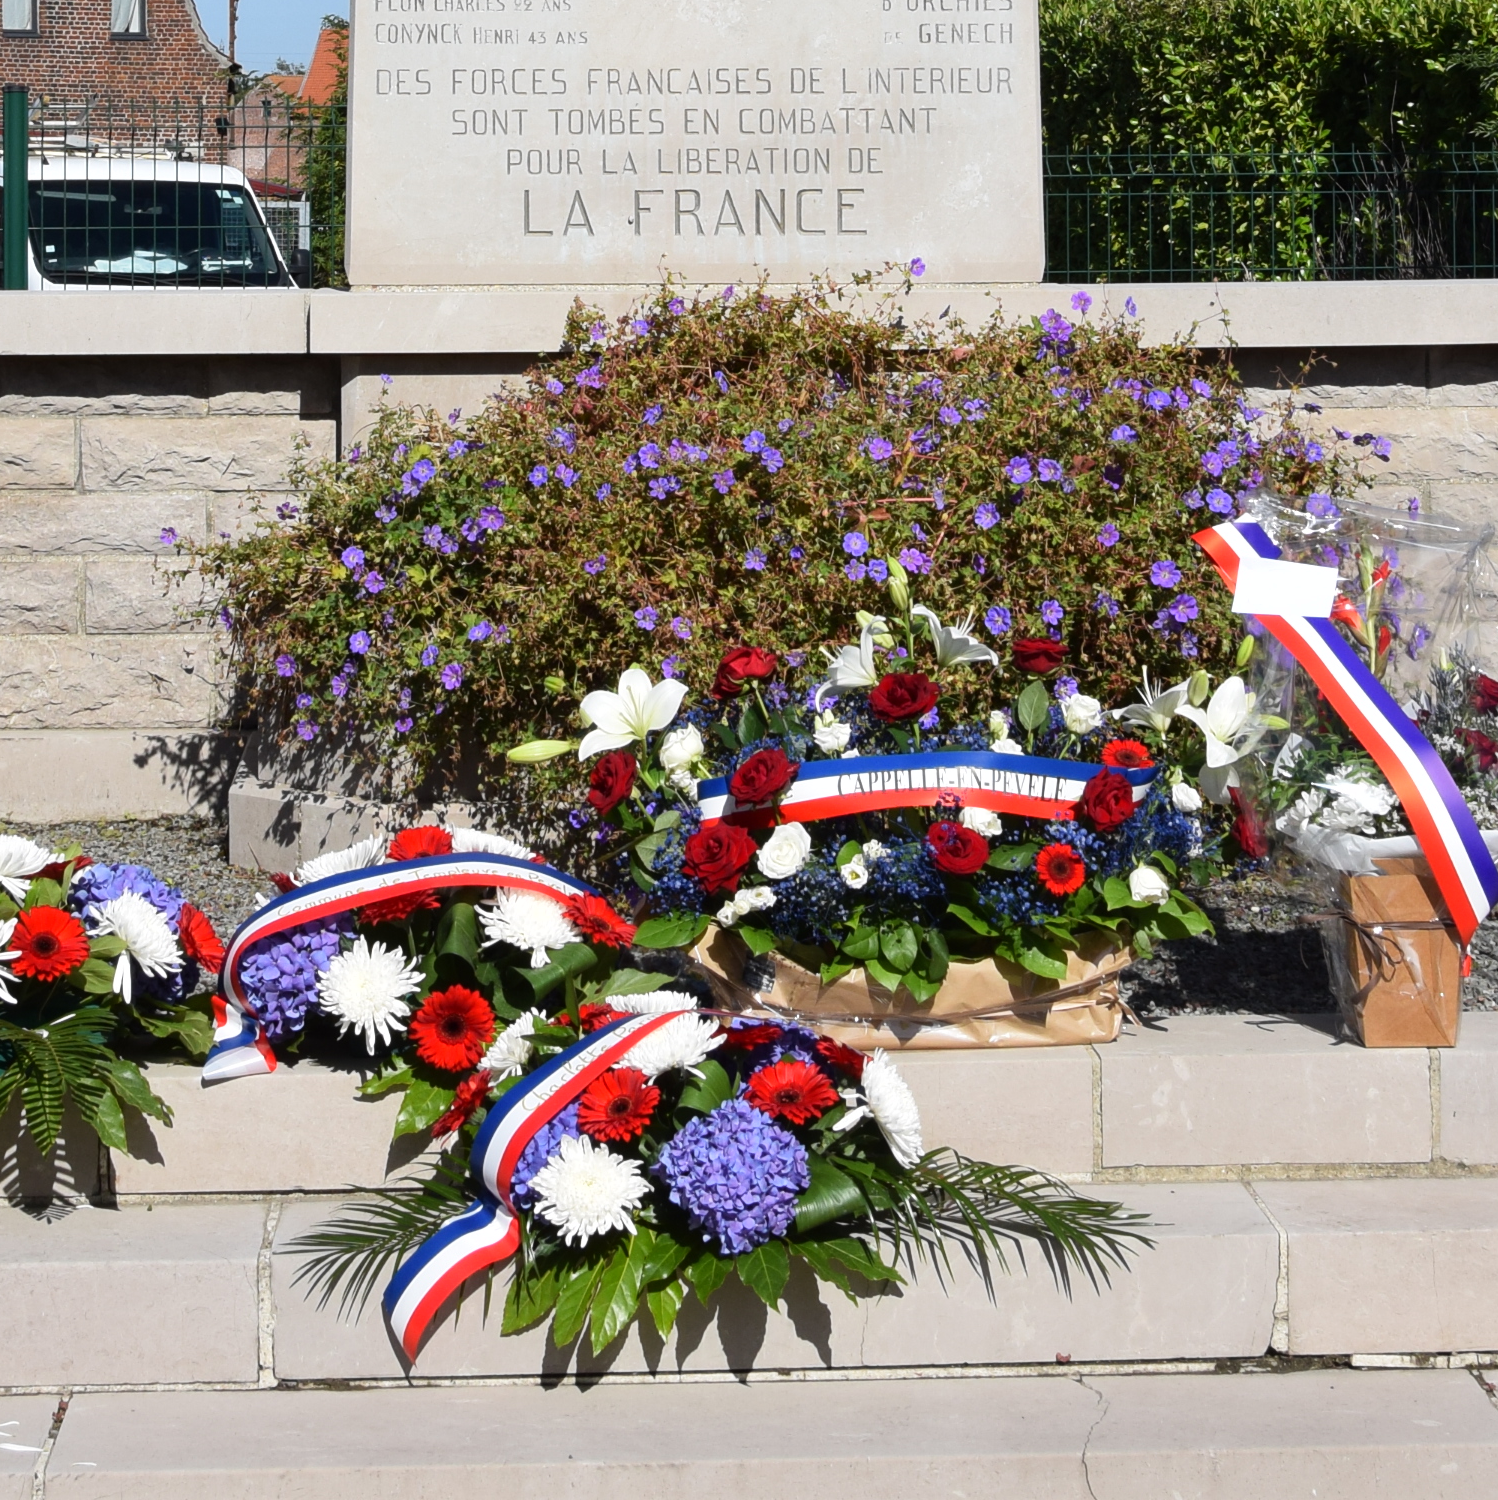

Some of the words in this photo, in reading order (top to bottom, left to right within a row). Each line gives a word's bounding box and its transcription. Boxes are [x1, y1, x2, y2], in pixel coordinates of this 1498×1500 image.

[514, 0, 533, 12] 22
[541, 0, 571, 12] ANS
[375, 24, 462, 44] CONYNCK
[473, 27, 519, 44] HENRI
[528, 32, 546, 44] 43
[556, 32, 588, 44] ANS
[919, 24, 1013, 44] GENECH
[376, 69, 432, 95] DES
[451, 69, 568, 95] FORCES
[790, 68, 825, 95] DE
[451, 109, 527, 134] SONT
[684, 109, 721, 134] EN
[739, 107, 937, 134] COMBATTANT
[507, 149, 583, 174] POUR
[603, 149, 637, 174] LA
[848, 148, 883, 174] DE
[524, 189, 593, 237] LA
[633, 188, 868, 237] FRANCE
[837, 766, 1069, 803] CAPPELLE-EN-PEVELE
